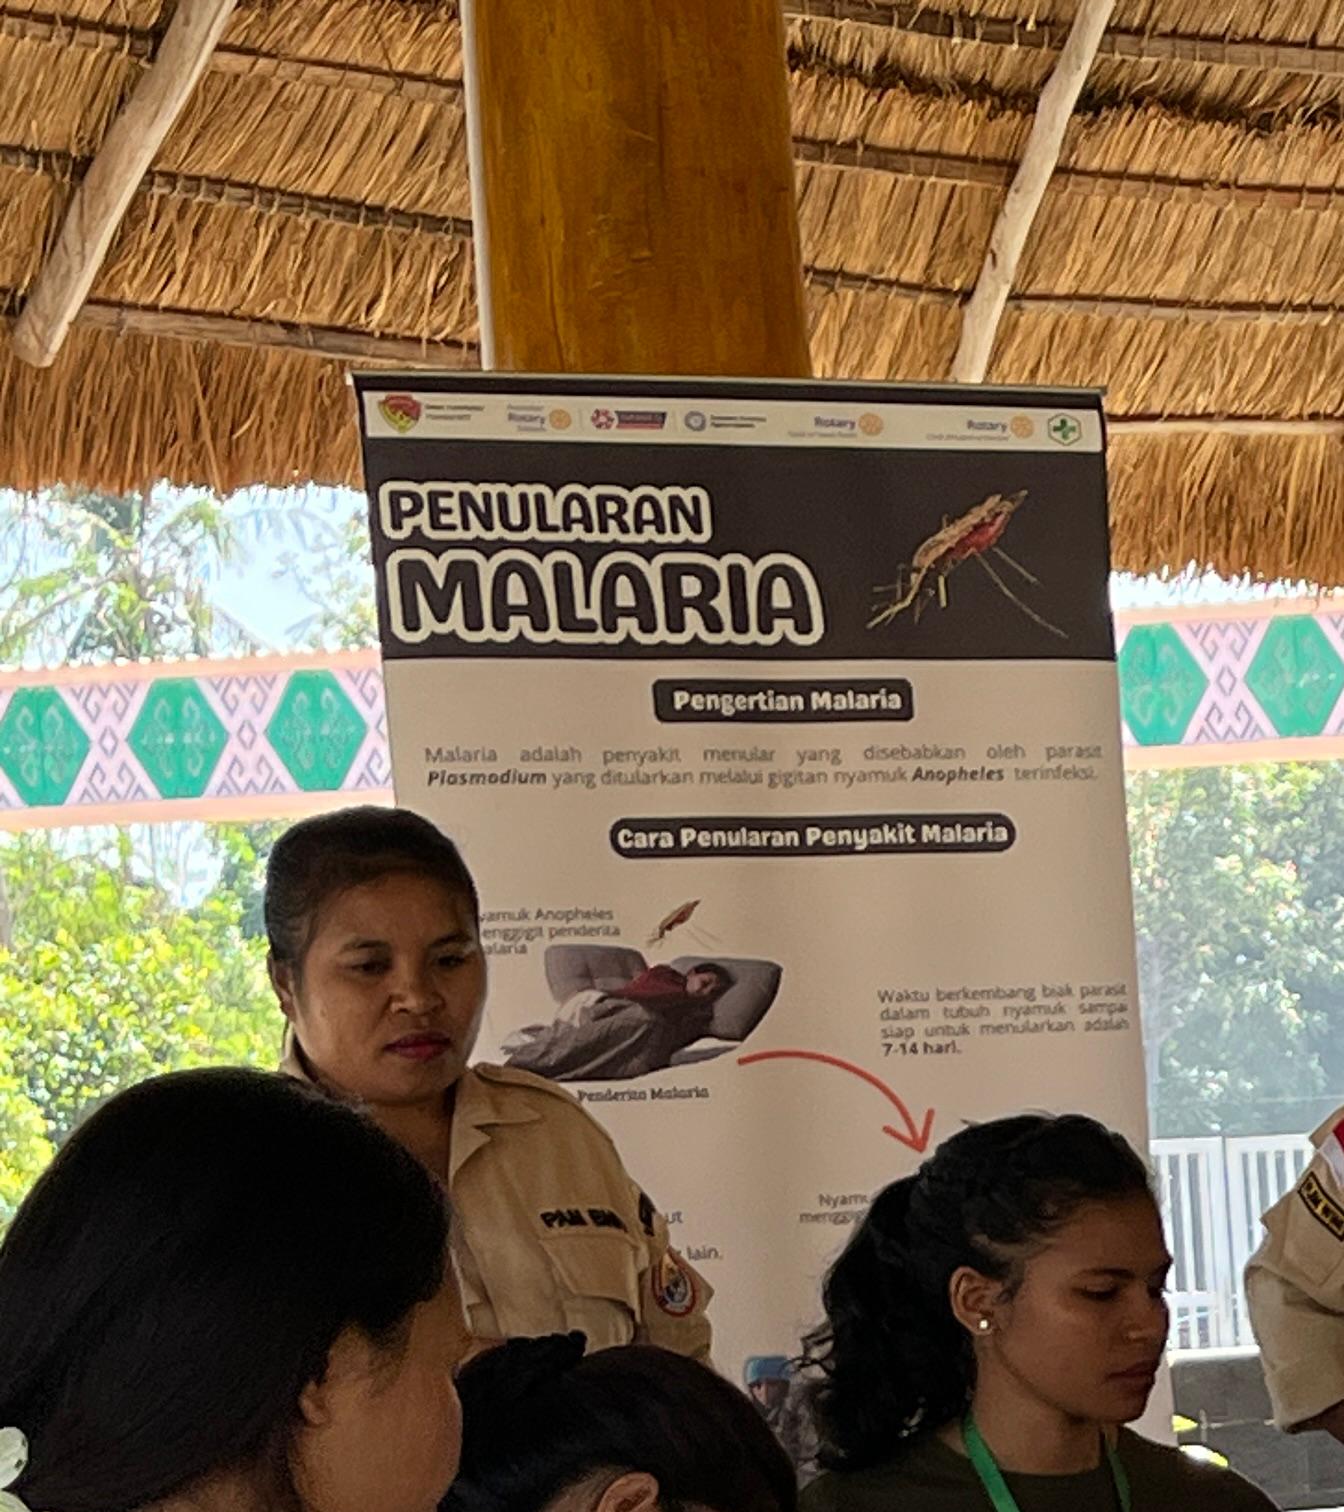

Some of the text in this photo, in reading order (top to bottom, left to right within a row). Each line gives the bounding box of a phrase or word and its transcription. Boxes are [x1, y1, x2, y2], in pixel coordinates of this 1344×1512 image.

[814, 416, 856, 430] Rotary
[967, 419, 1008, 433] Rotary
[380, 480, 712, 543] PENULARAN
[386, 549, 826, 646] MALARIA
[673, 689, 903, 716] Pengertian Malaria
[425, 747, 497, 762] Malaria
[520, 747, 582, 761] adalah
[603, 747, 681, 767] penyakit
[703, 747, 774, 762] menular
[797, 747, 842, 766] yang
[864, 744, 966, 761] disebabkan
[986, 744, 1027, 760] oleh
[427, 768, 547, 787] Plasmodium
[552, 771, 597, 789] yang
[601, 769, 693, 786] ditularkan
[700, 769, 762, 785] melalui
[768, 768, 827, 788] gigitan
[833, 767, 907, 788] nyamuk
[911, 766, 1005, 786] Anopheles
[617, 823, 1008, 851] Cara Penularan Penyakit Malaria
[534, 907, 613, 922] Anopheles
[482, 925, 621, 942] enggigit penderita
[484, 943, 527, 955] alaria
[878, 983, 1126, 1003] Waktu berkembang biak parasit
[881, 1006, 930, 1021] dalam
[943, 1005, 991, 1018] tubuh
[1003, 1002, 1066, 1020] nyamuk
[881, 1018, 1130, 1041] siap untuk menularkan adalah
[882, 1041, 918, 1056] 7-14
[651, 1085, 709, 1100] Malaria
